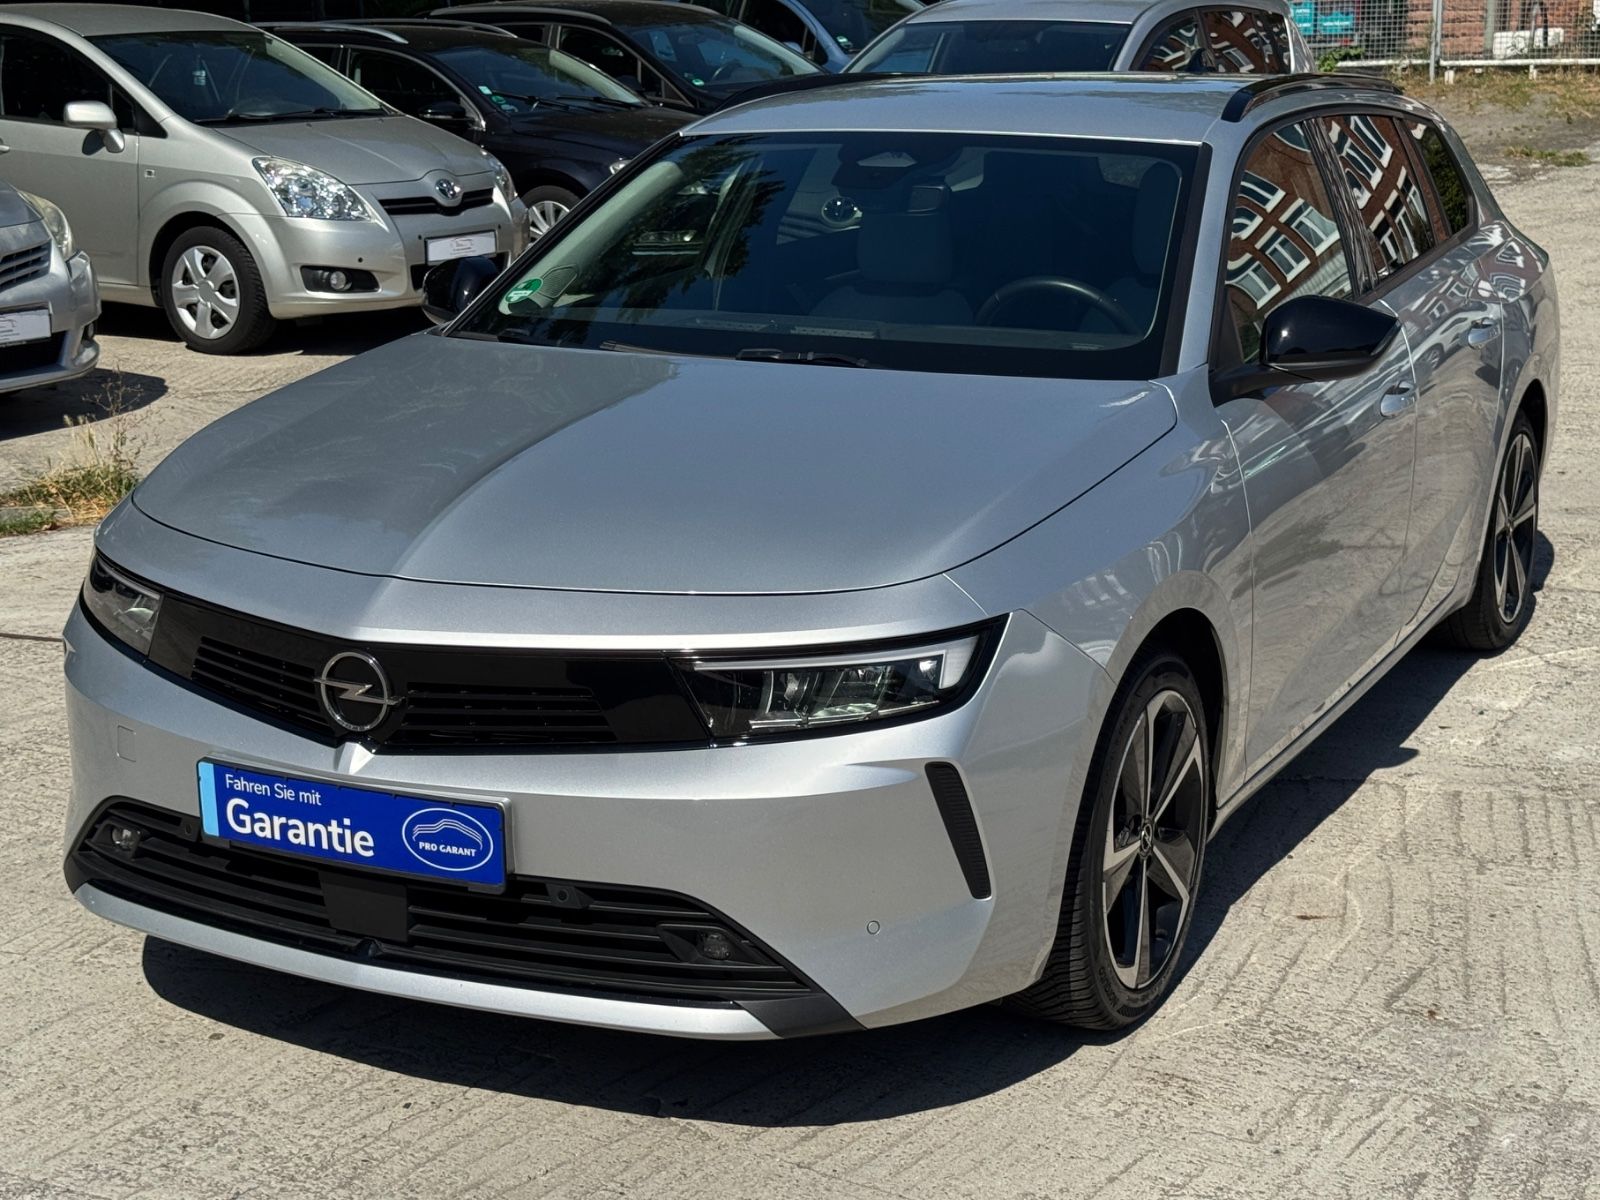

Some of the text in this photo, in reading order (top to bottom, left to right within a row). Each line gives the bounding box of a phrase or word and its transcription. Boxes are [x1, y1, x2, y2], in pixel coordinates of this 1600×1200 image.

[225, 773, 322, 806] Fahren Sie mit
[226, 798, 375, 857] Garantie
[419, 841, 476, 857] PRO GARANT
